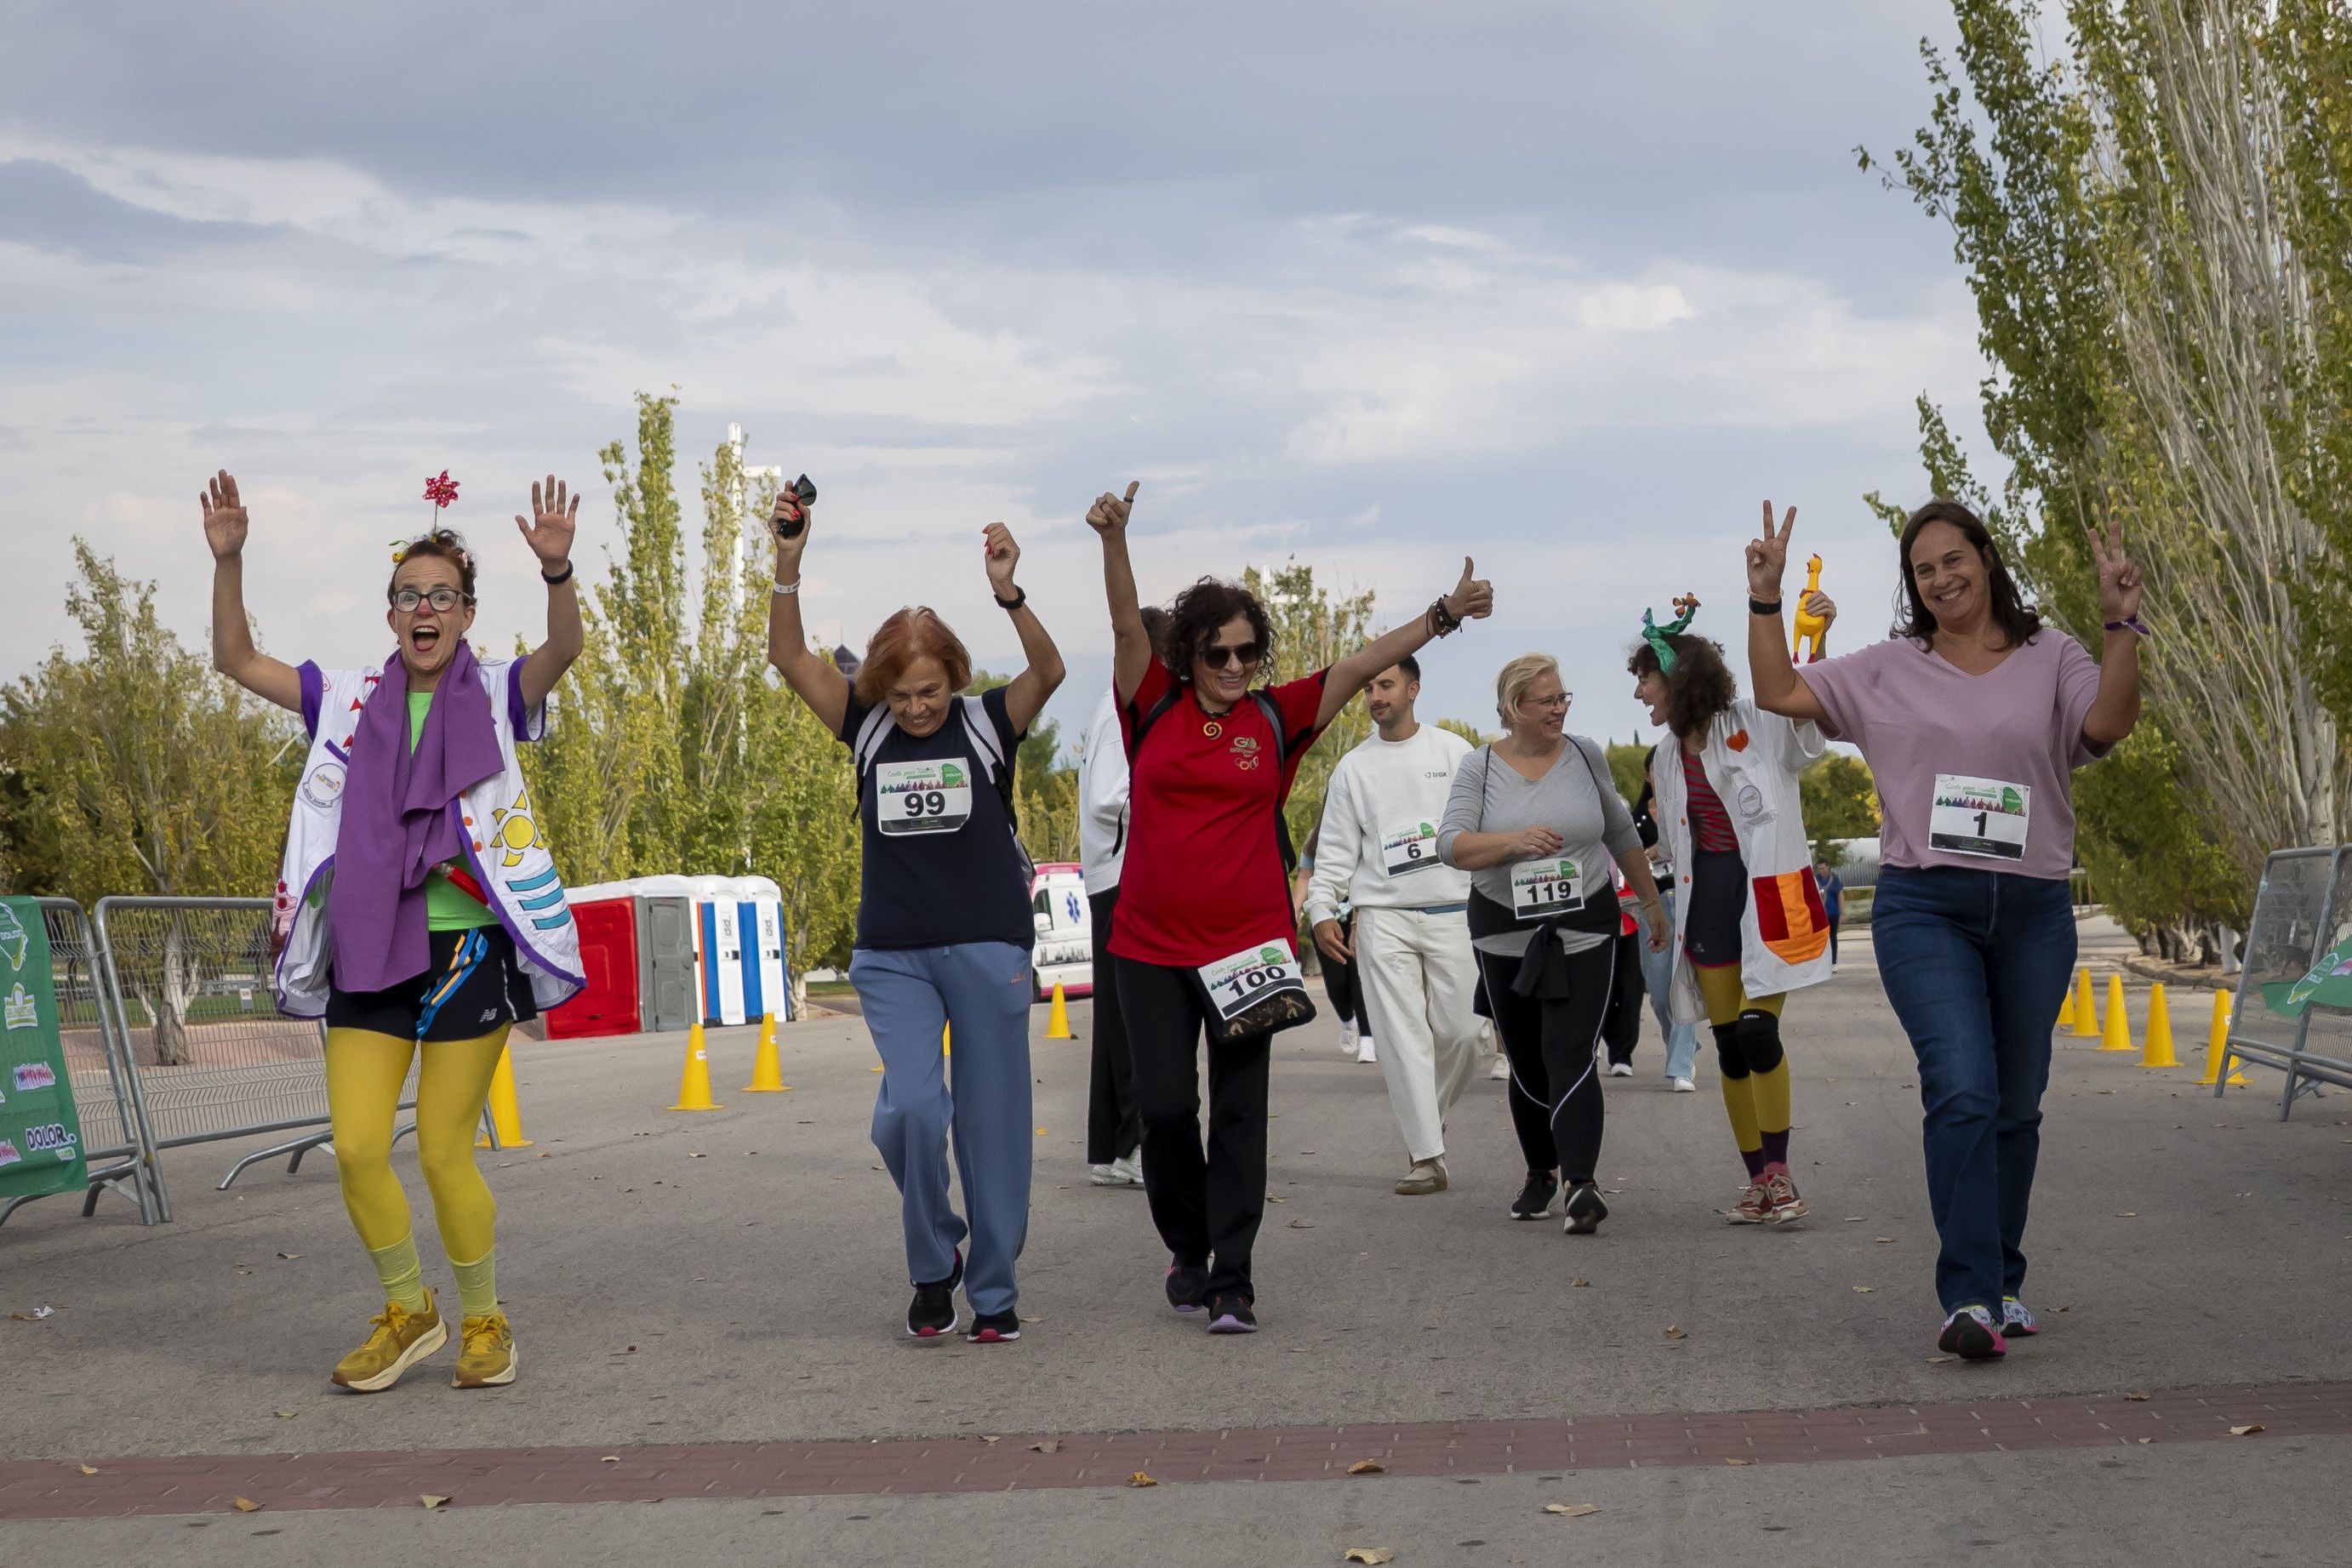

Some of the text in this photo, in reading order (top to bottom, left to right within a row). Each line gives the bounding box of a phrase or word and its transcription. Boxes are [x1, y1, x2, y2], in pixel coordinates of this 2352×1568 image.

[905, 791, 945, 817] 99
[1973, 812, 1987, 837] 1
[1407, 843, 1422, 859] 6
[1527, 881, 1572, 904] 119
[1228, 966, 1287, 997] 100
